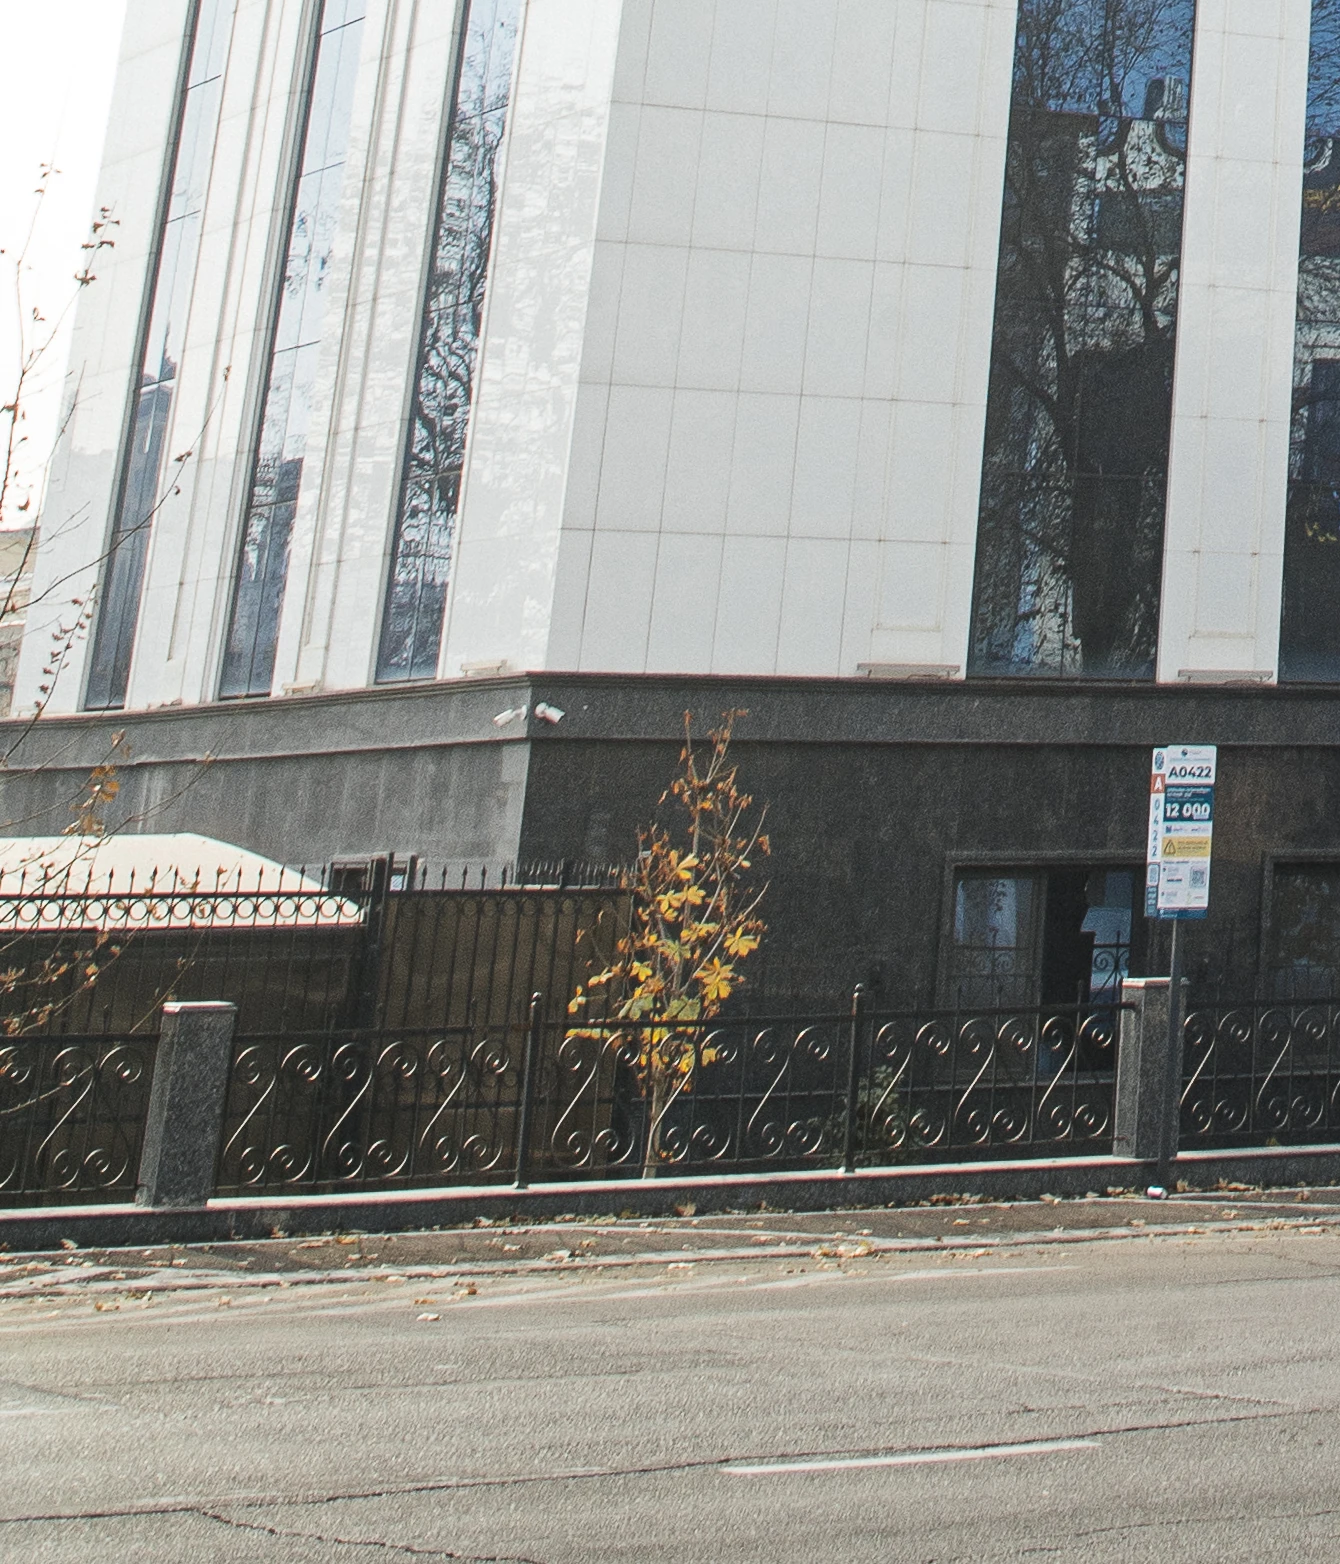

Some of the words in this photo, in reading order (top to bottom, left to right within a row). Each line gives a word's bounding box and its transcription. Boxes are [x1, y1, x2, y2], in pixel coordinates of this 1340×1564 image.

[1168, 765, 1212, 779] A0422
[1165, 802, 1180, 818] 12
[1182, 802, 1210, 818] 000
